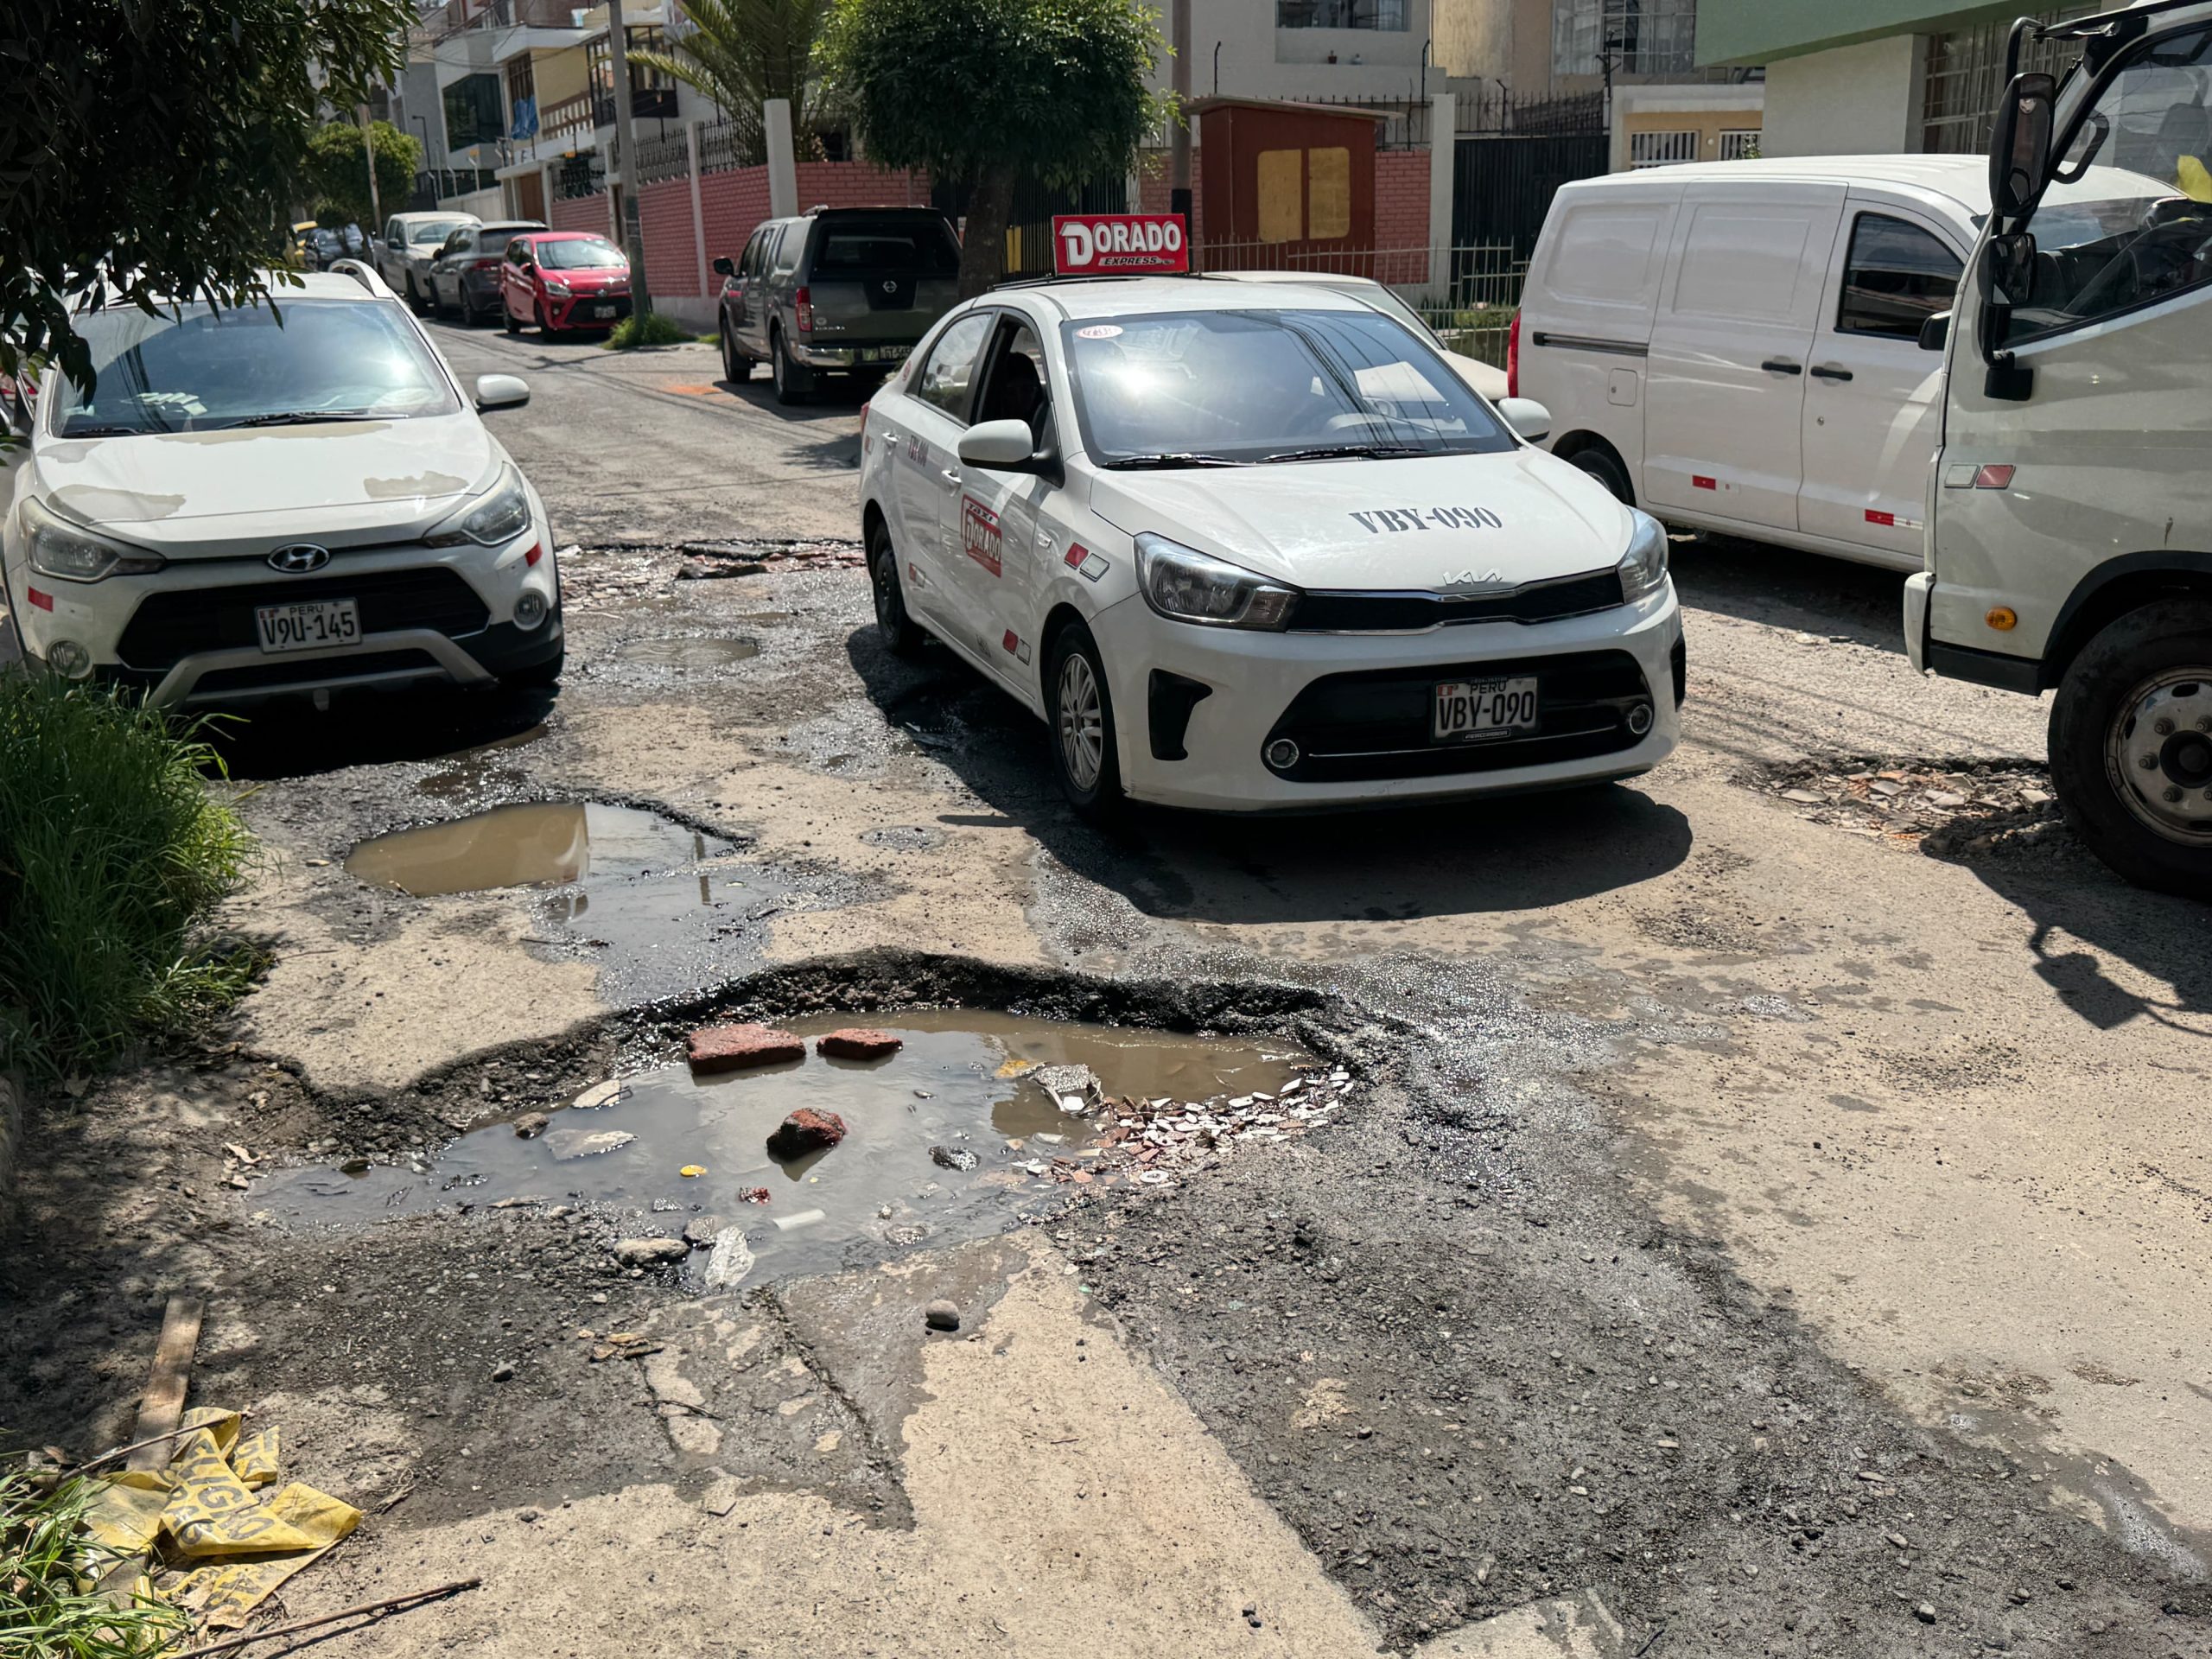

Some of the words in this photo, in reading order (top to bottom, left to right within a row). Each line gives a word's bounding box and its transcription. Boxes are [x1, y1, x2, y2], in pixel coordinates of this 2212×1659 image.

[1059, 220, 1181, 267] DORADO
[1103, 256, 1158, 265] EXPRESS
[969, 503, 993, 522] TAXI
[1348, 506, 1503, 534] VBY-090
[967, 512, 1001, 563] DORADO
[1442, 568, 1503, 587] KIA
[289, 605, 324, 616] PERU
[262, 611, 355, 645] V9U-145
[1470, 681, 1507, 695] PERU
[1439, 691, 1535, 730] VBY-090
